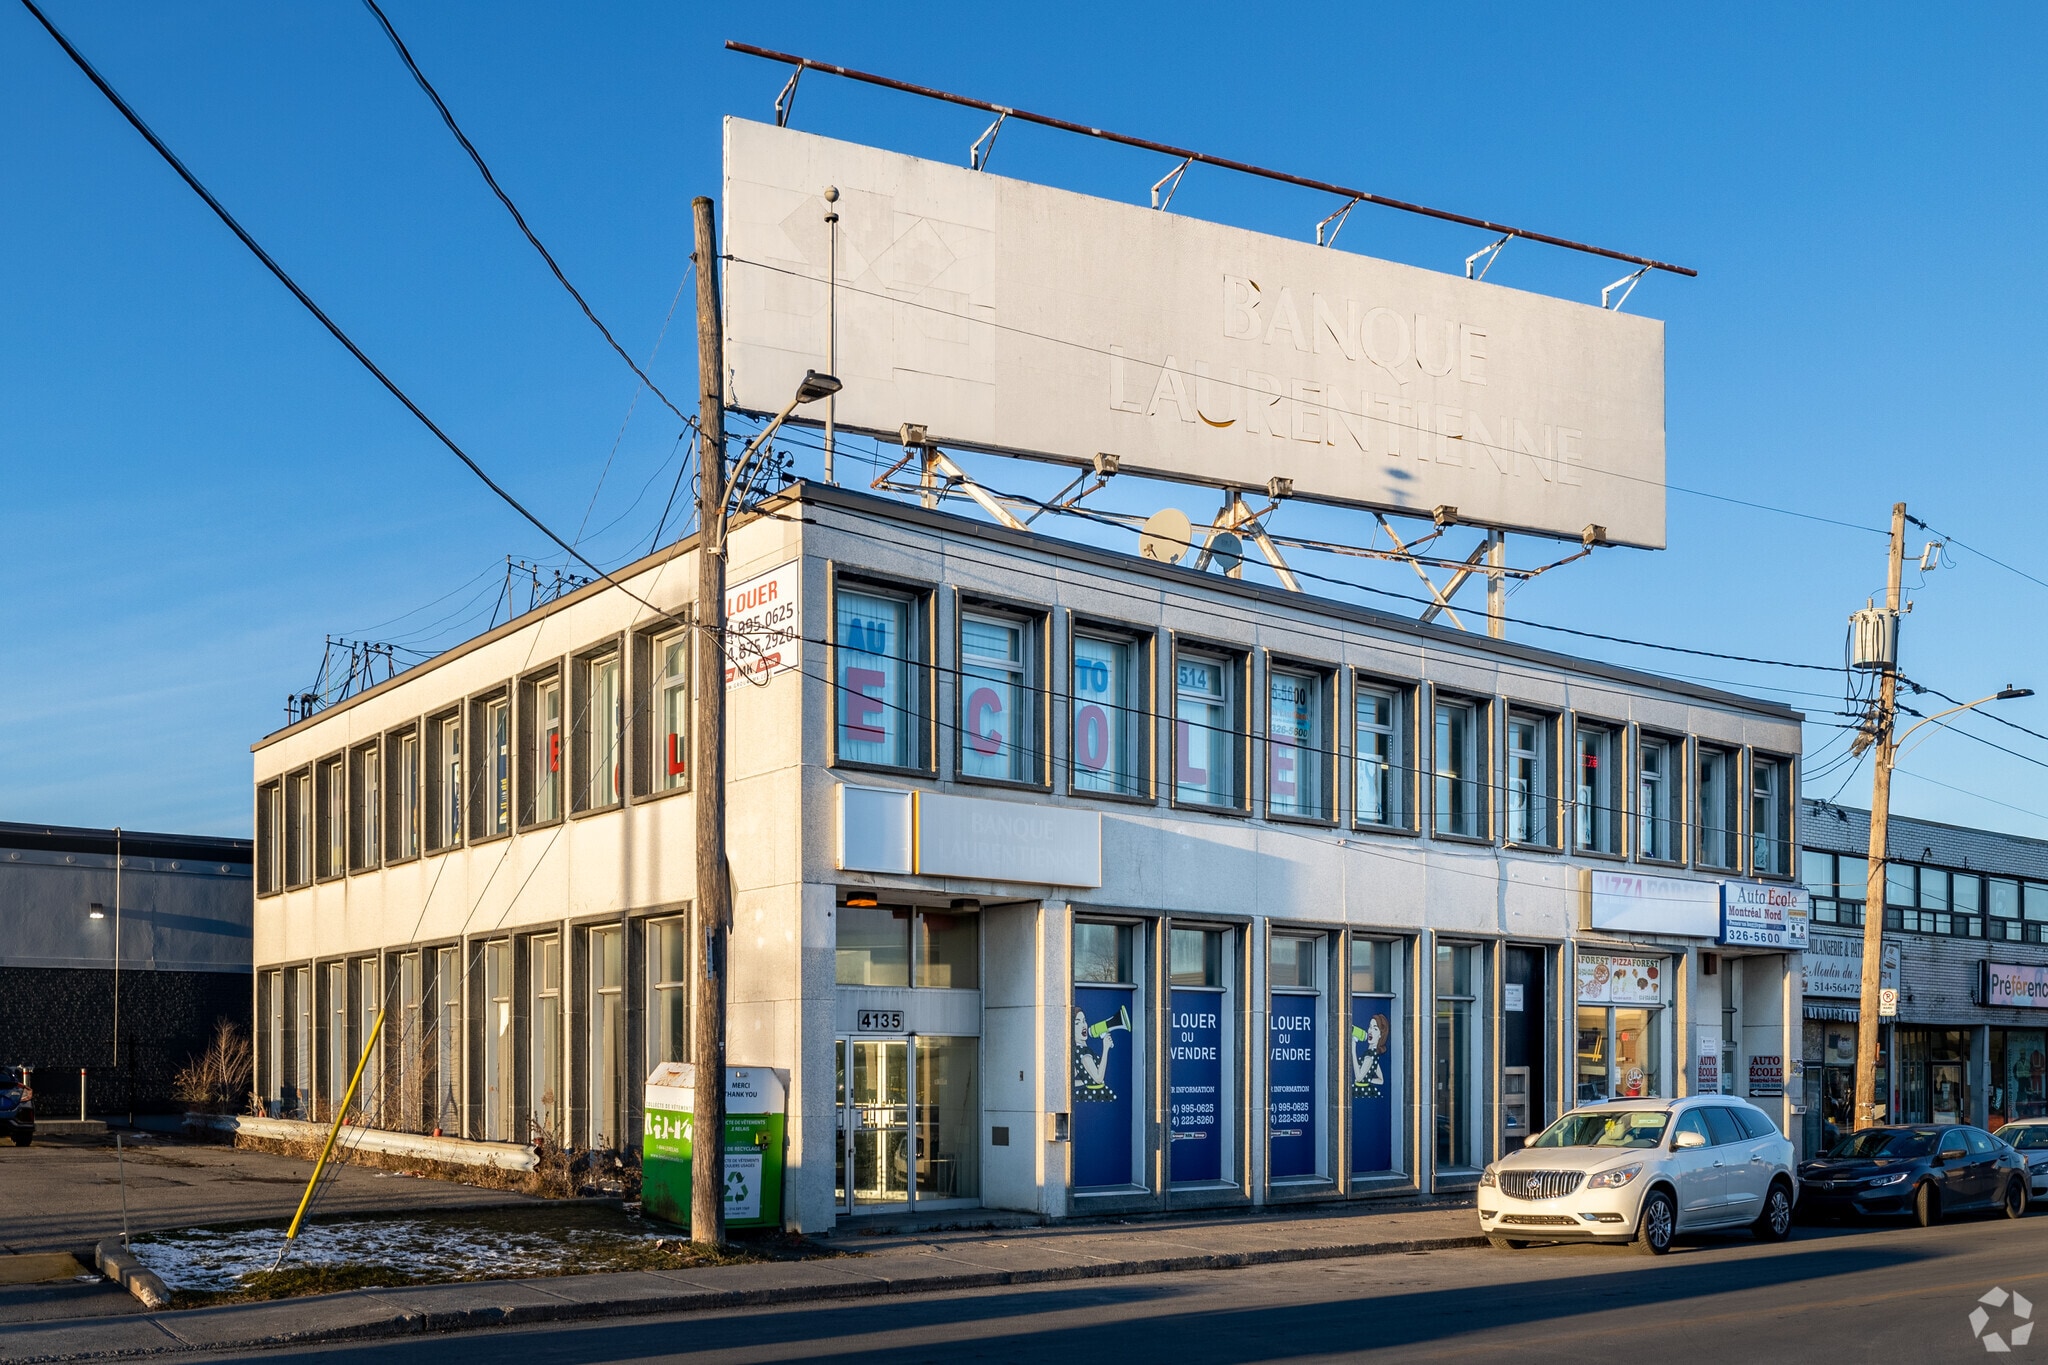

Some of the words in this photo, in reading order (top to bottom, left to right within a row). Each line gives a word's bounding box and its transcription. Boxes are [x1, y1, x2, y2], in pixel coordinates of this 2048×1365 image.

[1223, 273, 1488, 387] BANQUE
[1109, 343, 1584, 488] LAURENTIENNE
[728, 582, 778, 615] LOUER
[847, 617, 886, 655] AU
[1076, 658, 1108, 693] TO
[1180, 666, 1207, 688] 514
[971, 811, 1054, 842] BANQUE
[938, 838, 1086, 872] LAURENTIENNE
[1598, 875, 1643, 897] IZZA
[1737, 886, 1766, 905] Auto
[1768, 887, 1798, 908] École
[1728, 905, 1761, 919] Montréal
[1764, 908, 1782, 921] Nord
[1729, 929, 1780, 943] 326-5600
[1803, 938, 1843, 957] OULANGERIE
[1809, 960, 1841, 979] Moulin
[1842, 963, 1853, 979] du
[861, 1013, 901, 1028] 4135
[1172, 1012, 1217, 1029] LOUER
[1270, 1015, 1311, 1031] LOUER
[1181, 1031, 1194, 1043] OU
[1278, 1033, 1291, 1044] OU
[1170, 1046, 1217, 1060] VENDRE
[1699, 1056, 1717, 1066] AUTO
[1751, 1056, 1781, 1066] AUTO
[1698, 1066, 1718, 1077] ÉCOLE
[1749, 1066, 1783, 1077] ÉCOLE
[1176, 1085, 1215, 1094] INFORMATION
[1273, 1085, 1310, 1093] INFORMATION
[1181, 1103, 1214, 1113] 995-0625
[1278, 1102, 1309, 1112] 995-0625
[1181, 1115, 1214, 1125] 222-5260
[1278, 1114, 1309, 1123] 222-5260
